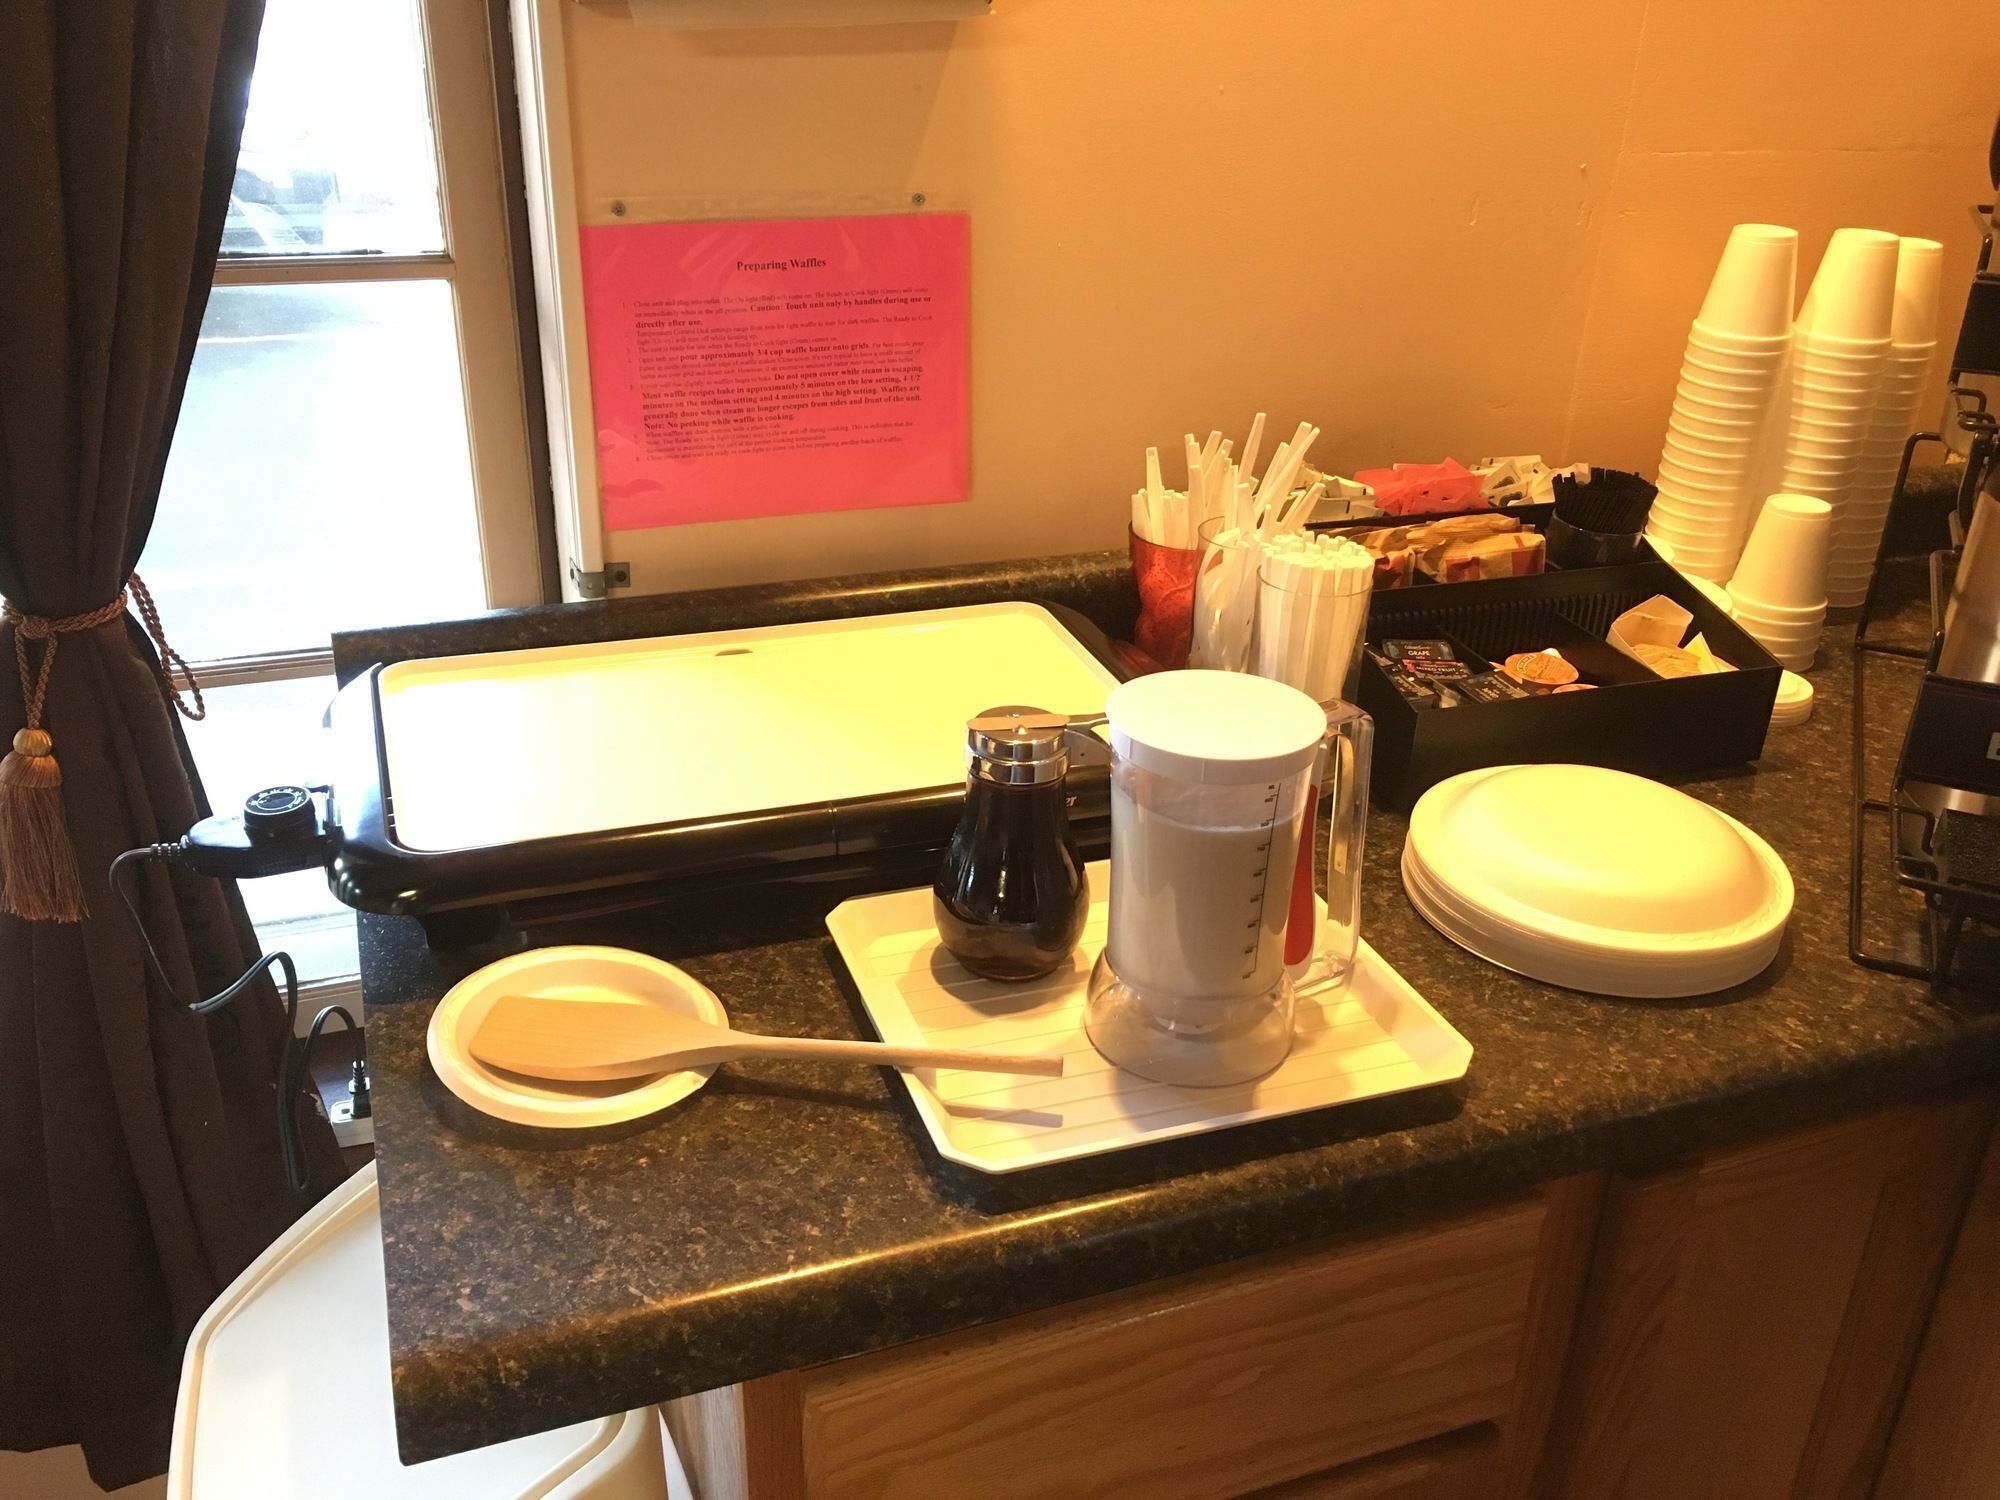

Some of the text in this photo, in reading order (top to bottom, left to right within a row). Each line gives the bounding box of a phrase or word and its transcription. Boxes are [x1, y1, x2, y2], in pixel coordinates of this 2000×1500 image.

[736, 258, 826, 272] Preparing Waffles
[750, 302, 780, 311] Caution:
[826, 299, 840, 308] only
[843, 299, 851, 307] by
[854, 297, 881, 305] handles
[884, 296, 908, 305] during
[635, 320, 664, 330] directly
[700, 349, 754, 360] approximately
[688, 388, 714, 397] recipes
[745, 382, 798, 393] approximately
[806, 380, 834, 388] minutes
[642, 401, 672, 409] minutes
[700, 397, 730, 405] medium
[732, 395, 757, 404] setting
[780, 391, 809, 399] minutes
[835, 388, 850, 397] high
[643, 411, 677, 421] generally
[757, 404, 779, 413] longer
[680, 419, 709, 428] peeking
[764, 412, 794, 422] cooking.
